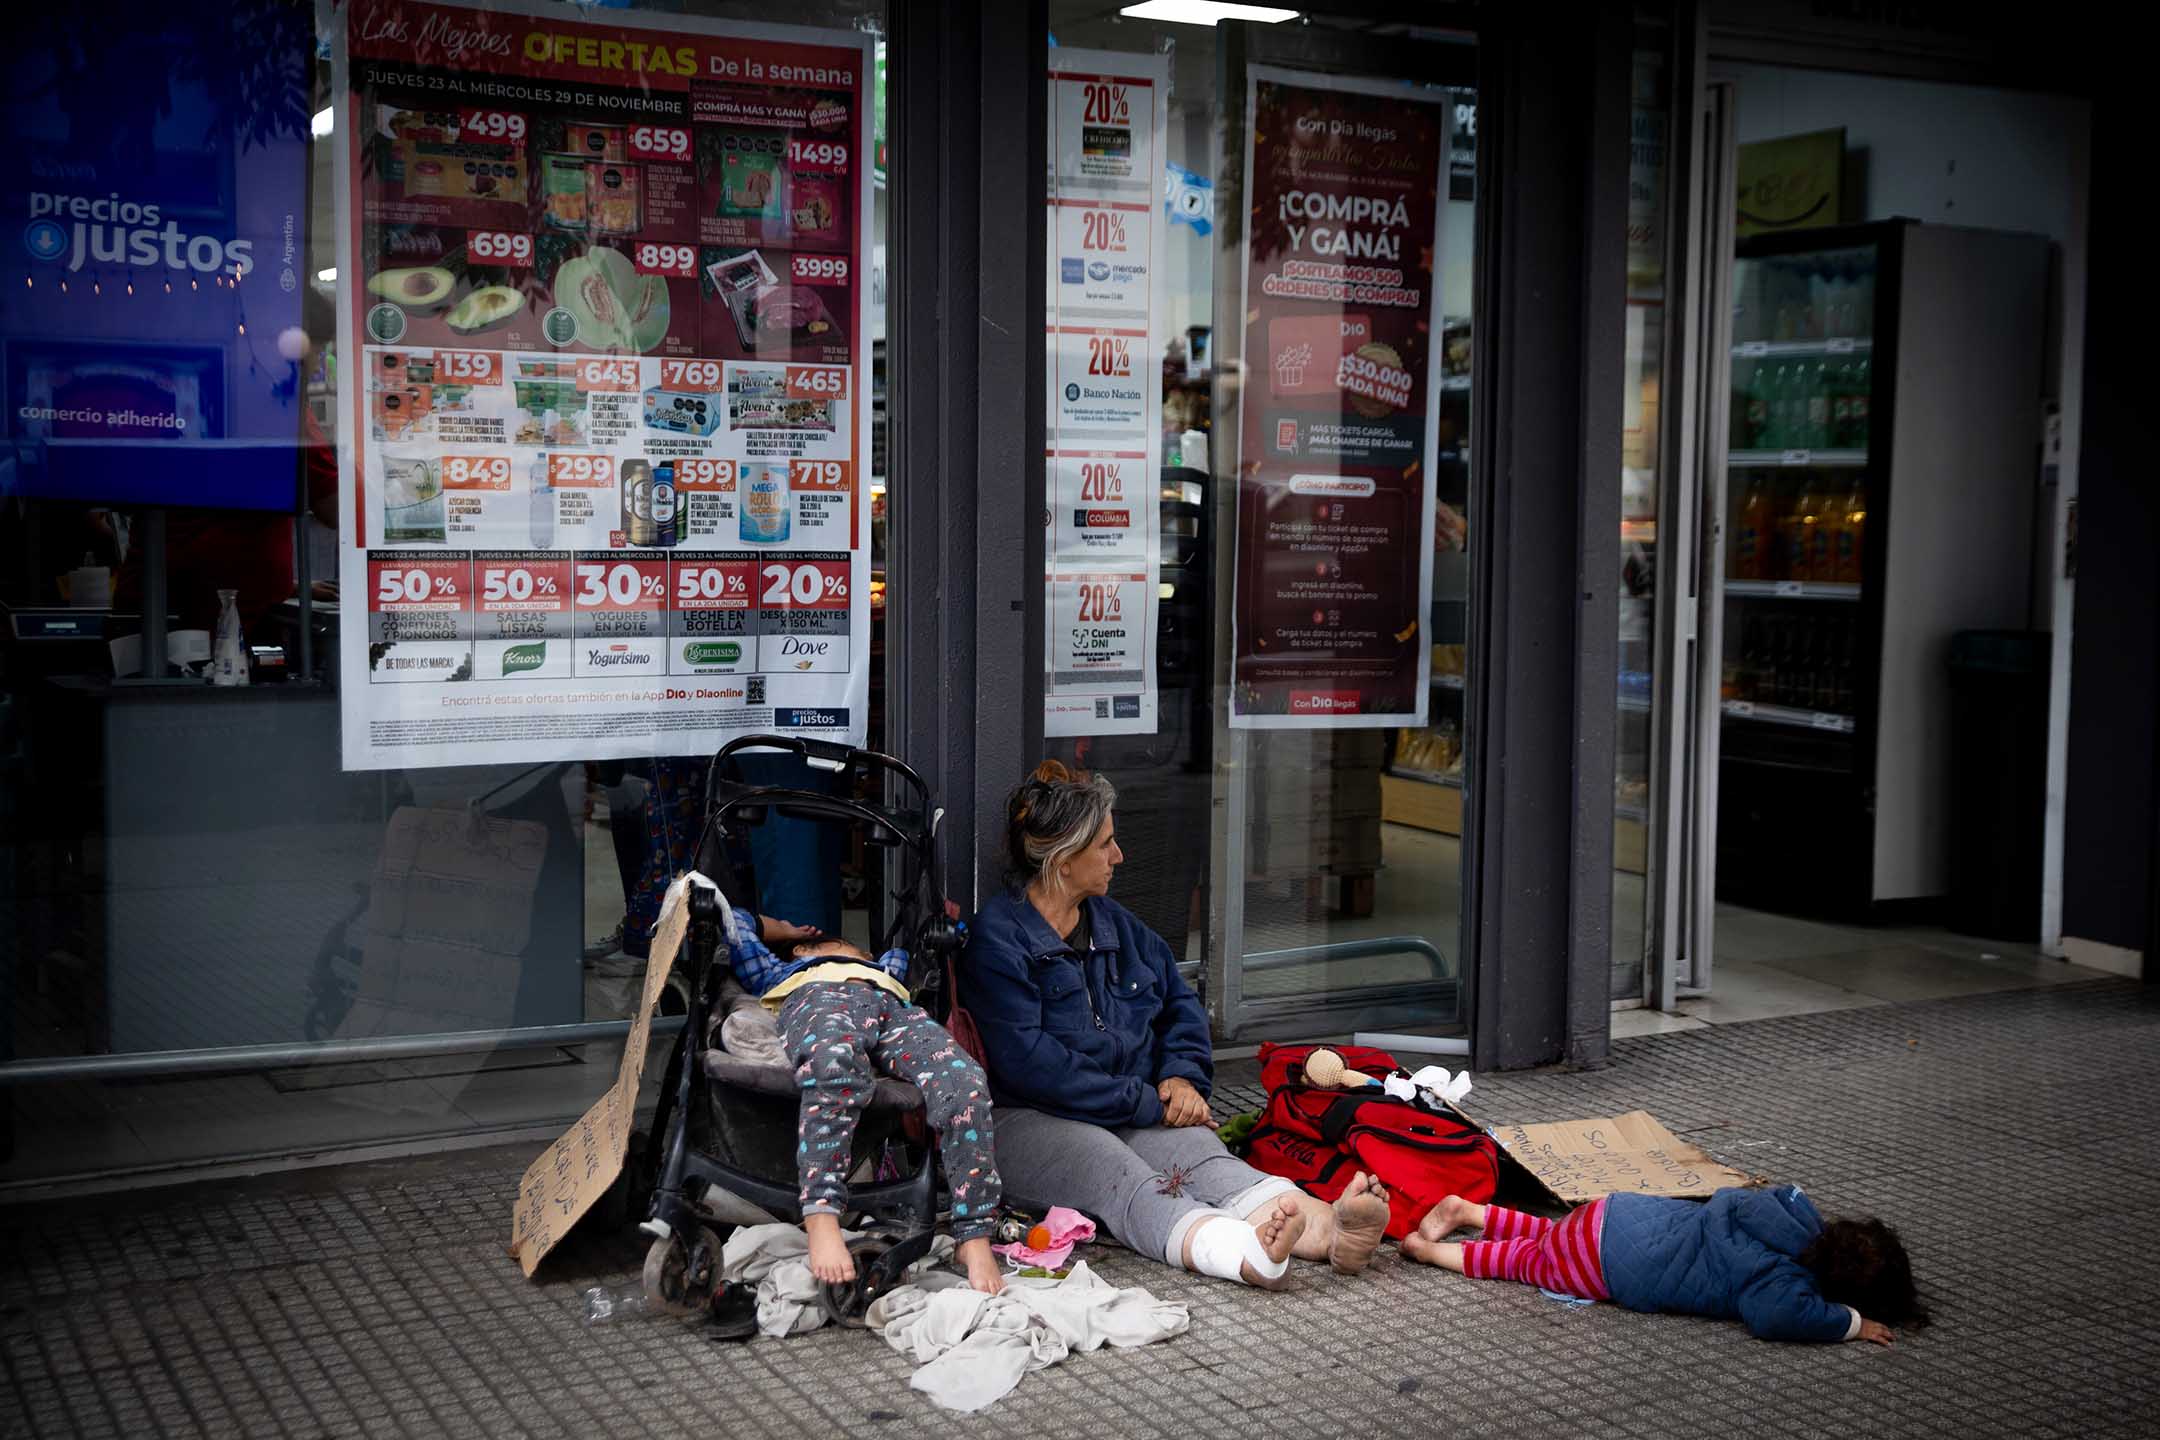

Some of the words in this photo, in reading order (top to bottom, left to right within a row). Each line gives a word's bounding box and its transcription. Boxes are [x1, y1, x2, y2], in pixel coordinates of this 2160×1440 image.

[361, 5, 409, 43] Las
[415, 13, 514, 60] Mejores
[523, 32, 698, 76] OFERTAS
[710, 56, 739, 75] De
[745, 58, 763, 79] la
[769, 64, 853, 85] semana
[367, 71, 424, 87] JUEVES
[428, 77, 444, 90] 23
[449, 80, 466, 93] AL
[555, 91, 571, 104] 29
[575, 93, 594, 106] DE
[598, 95, 682, 114] NOVIEMBRE
[1084, 84, 1129, 124] 20%
[1296, 116, 1326, 133] Con
[30, 192, 161, 226] precios
[1280, 191, 1410, 229] ¡COMPRÁ
[283, 214, 295, 264] Argentina
[1083, 212, 1125, 250] 20%
[1286, 224, 1307, 251] Y
[1310, 226, 1400, 260] GANÁ!
[69, 221, 254, 275] justos
[468, 232, 531, 258] $699
[1112, 264, 1146, 274] mercado
[1378, 270, 1401, 284] 500
[1334, 283, 1352, 299] DE
[435, 354, 492, 379] $139
[1088, 338, 1130, 376] 20%
[577, 363, 637, 385] $645
[662, 360, 721, 385] $769
[787, 370, 842, 393] $465
[1084, 387, 1110, 399] Banco
[1112, 387, 1141, 400] Nación
[1336, 374, 1374, 398] CADA
[1378, 385, 1410, 408] UNA!
[19, 405, 102, 423] comercio
[107, 410, 186, 430] adherido
[739, 399, 772, 415] Avena
[444, 459, 511, 484] $849
[550, 457, 612, 482] $299
[674, 462, 734, 485] $599
[790, 462, 842, 485] $719
[752, 483, 778, 492] MEGA
[1081, 464, 1122, 501] 20%
[1090, 513, 1128, 524] COLUMBIA
[378, 569, 456, 602] 50%
[483, 569, 557, 601] 50%
[576, 564, 665, 606] 30%
[677, 568, 746, 598] 50%
[762, 564, 848, 604] 20%
[1079, 584, 1120, 622] 20%
[382, 621, 457, 632] CONFITURAS
[497, 612, 547, 622] SALSAS
[590, 612, 648, 622] YOGURES
[683, 611, 725, 620] LECHE
[728, 611, 745, 620] EN
[760, 610, 847, 620] DESODORANTES
[780, 620, 787, 628] X
[790, 620, 806, 628] 150
[383, 631, 390, 640] Y
[393, 631, 457, 640] PIONONOS
[500, 622, 544, 633] LISTAS
[595, 622, 614, 632] EN
[616, 622, 646, 632] POTE
[1091, 629, 1126, 638] Cuenta
[781, 636, 829, 656] Dove
[1092, 639, 1108, 648] DNI
[396, 658, 416, 669] TODAS
[504, 652, 542, 664] Knorr
[442, 694, 492, 706] Encontrá
[495, 694, 523, 704] estas
[526, 692, 565, 704] ofertas
[568, 692, 610, 703] también
[615, 692, 628, 700] en
[632, 691, 640, 700] la
[642, 690, 664, 702] App
[687, 690, 693, 701] y
[800, 713, 836, 726] justos
